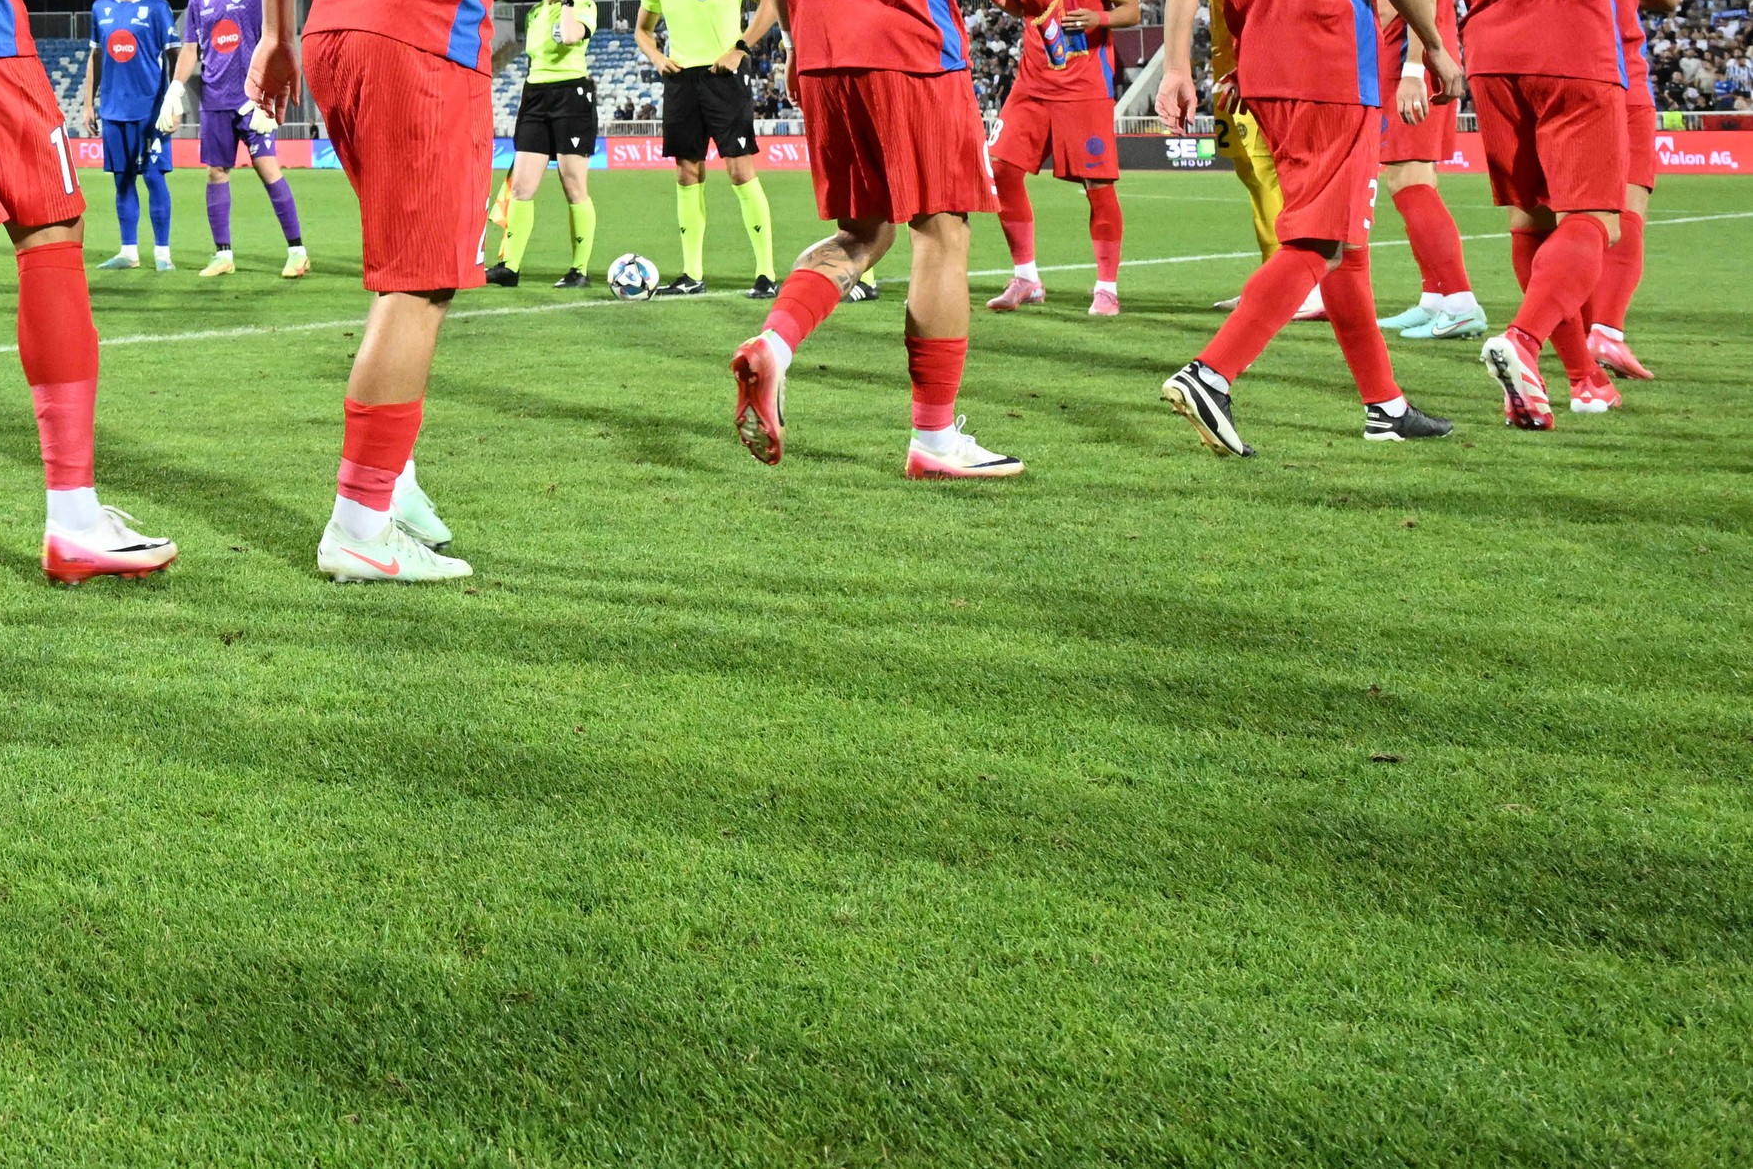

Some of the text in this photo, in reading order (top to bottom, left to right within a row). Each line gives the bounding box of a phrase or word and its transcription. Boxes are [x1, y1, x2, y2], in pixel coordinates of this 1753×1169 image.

[1165, 138, 1198, 159] 3E
[1172, 158, 1212, 168] GROUP
[1659, 150, 1706, 166] Valon
